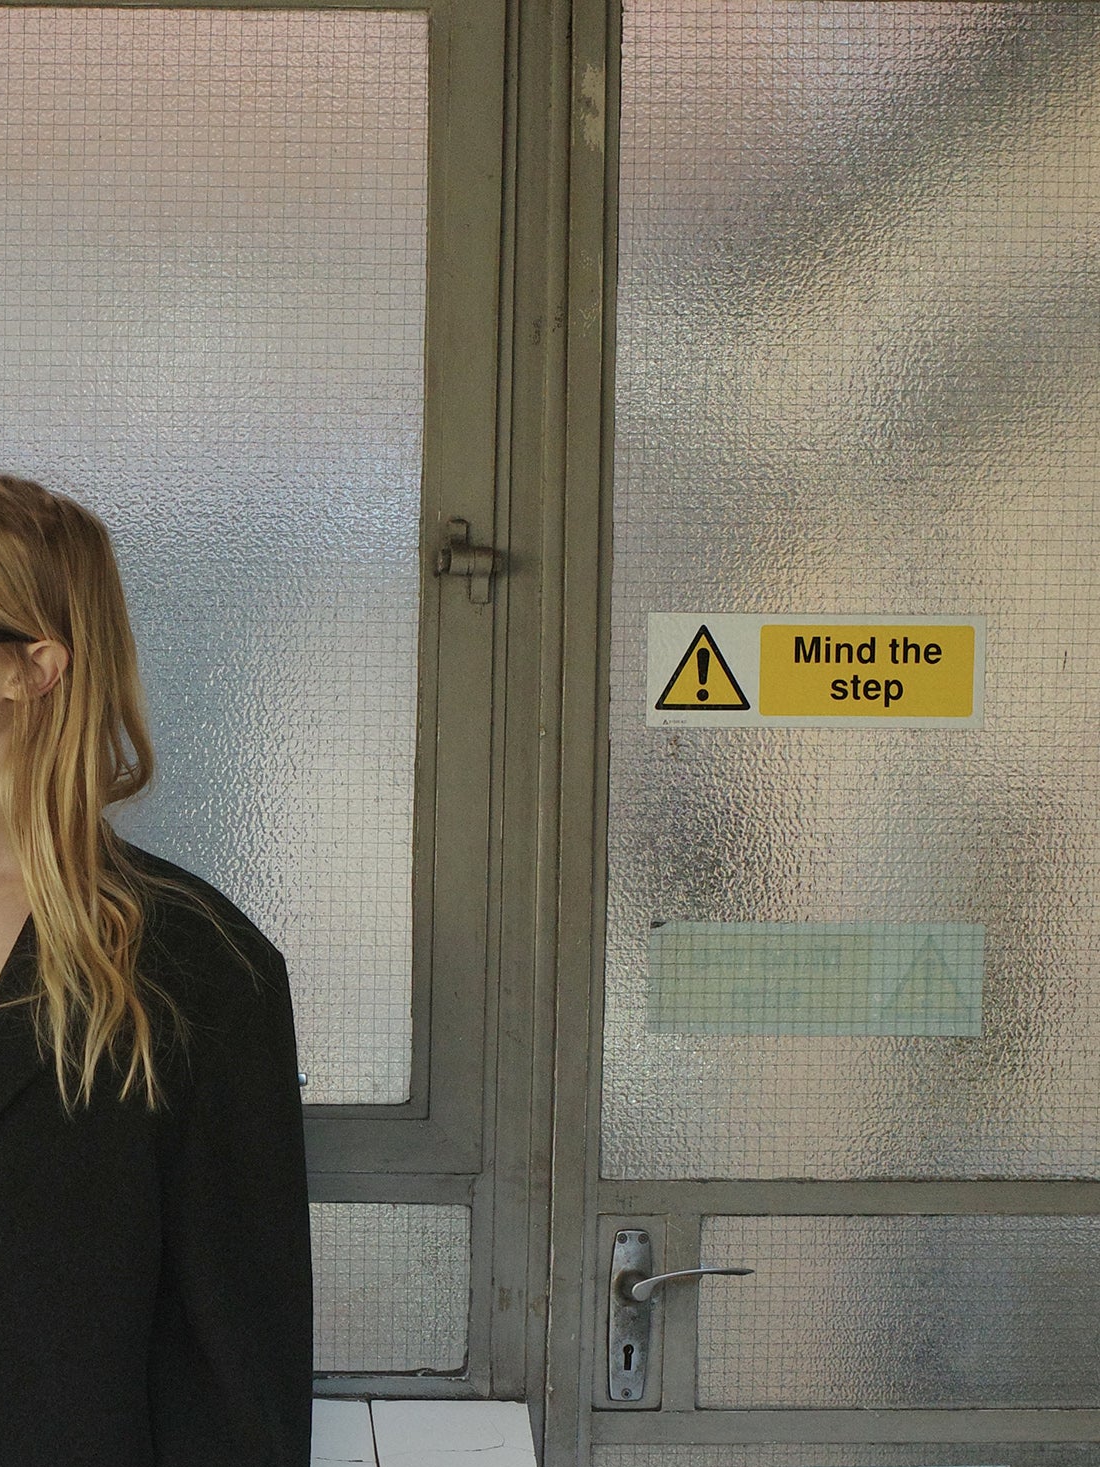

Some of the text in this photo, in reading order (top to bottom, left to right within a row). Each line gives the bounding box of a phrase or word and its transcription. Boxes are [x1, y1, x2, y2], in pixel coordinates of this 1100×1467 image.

[794, 636, 943, 665] Mind the
[830, 674, 904, 708] step
